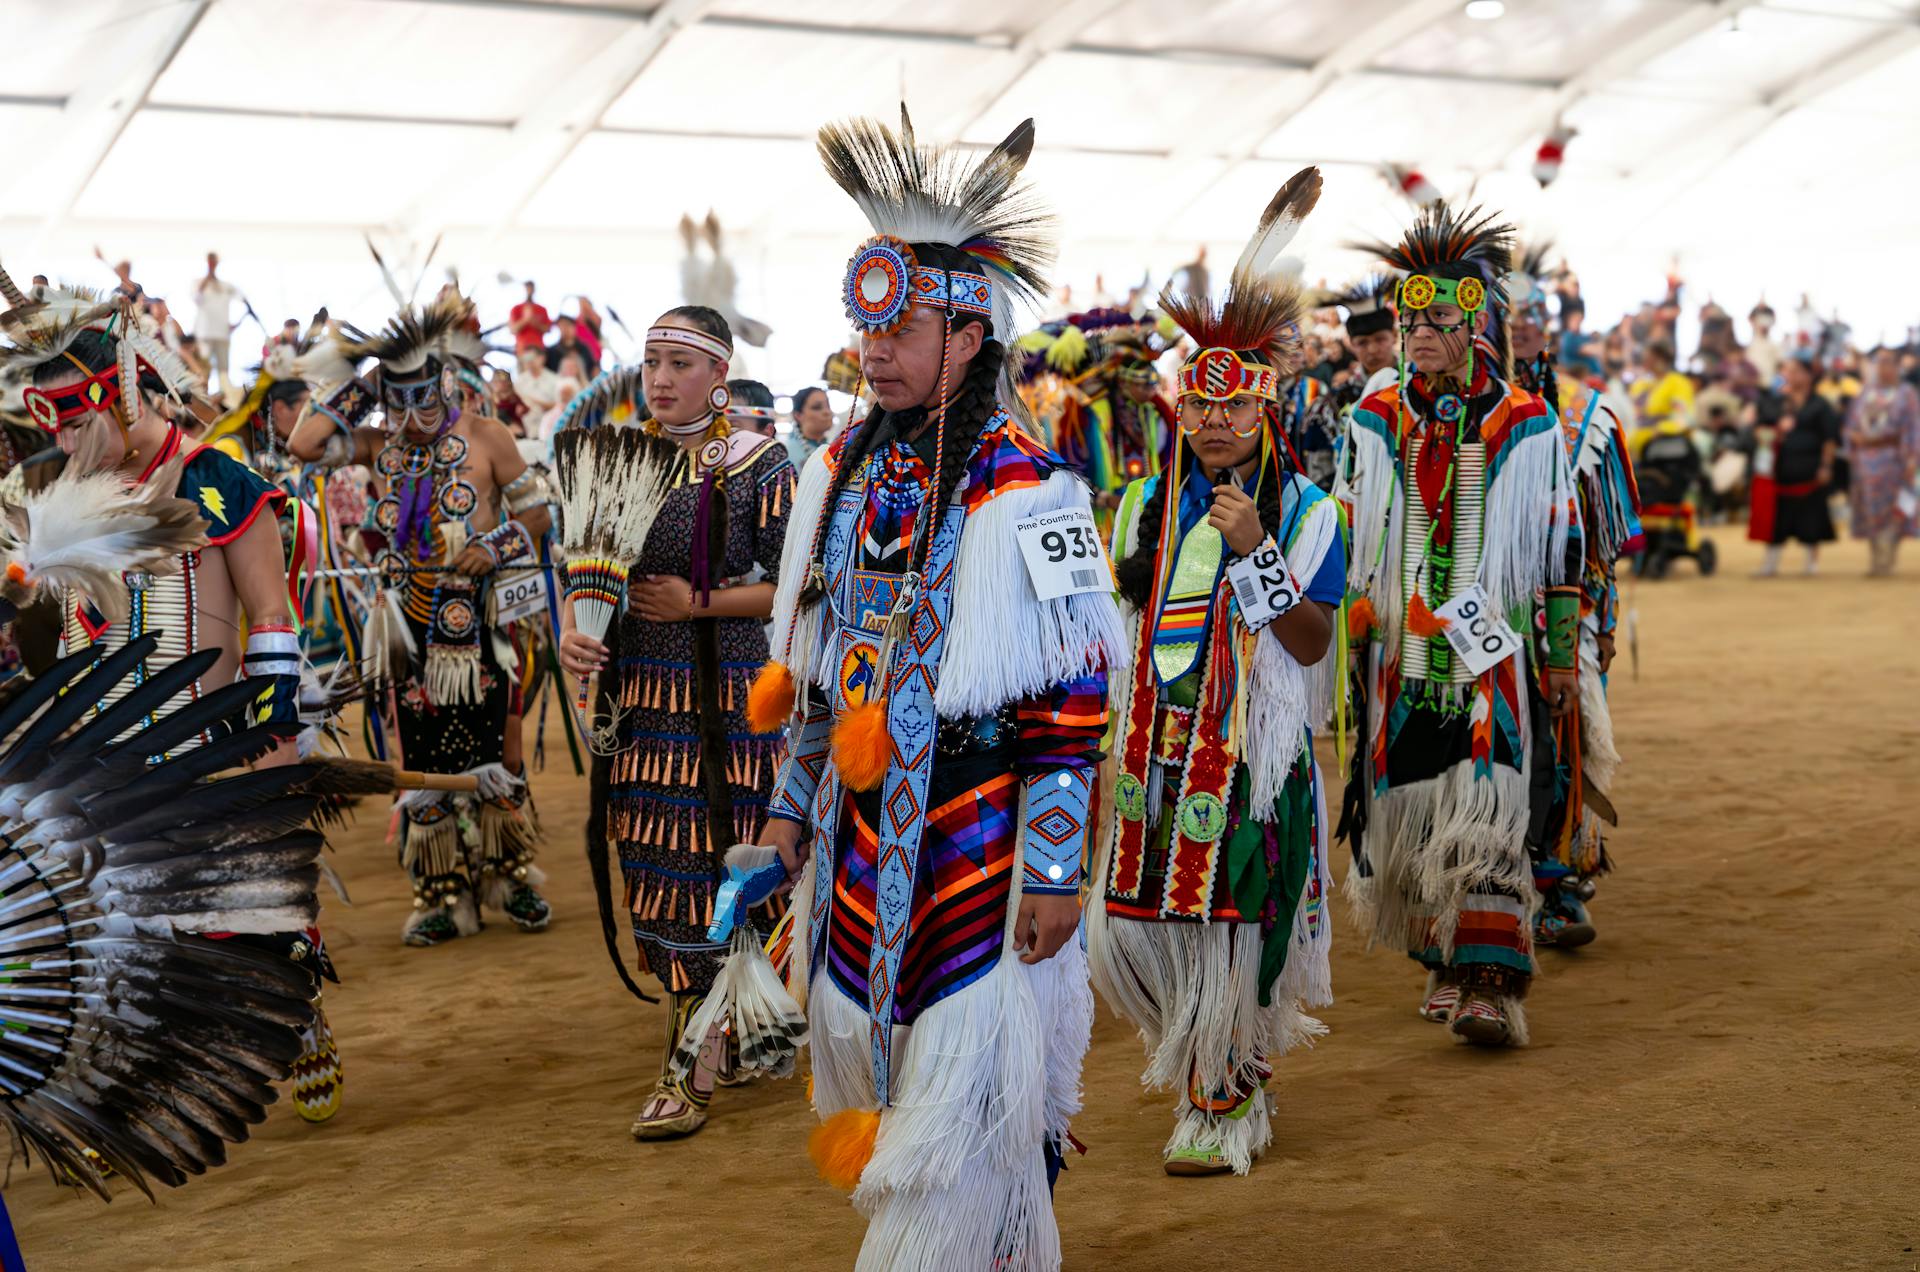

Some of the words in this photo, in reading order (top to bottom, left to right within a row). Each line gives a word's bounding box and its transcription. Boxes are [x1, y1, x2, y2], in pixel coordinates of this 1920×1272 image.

[1017, 521, 1038, 532] Pine
[1039, 514, 1074, 526] Country
[1040, 526, 1099, 563] 935
[504, 580, 539, 606] 904
[1253, 549, 1293, 612] 920
[1457, 600, 1503, 653] 900
